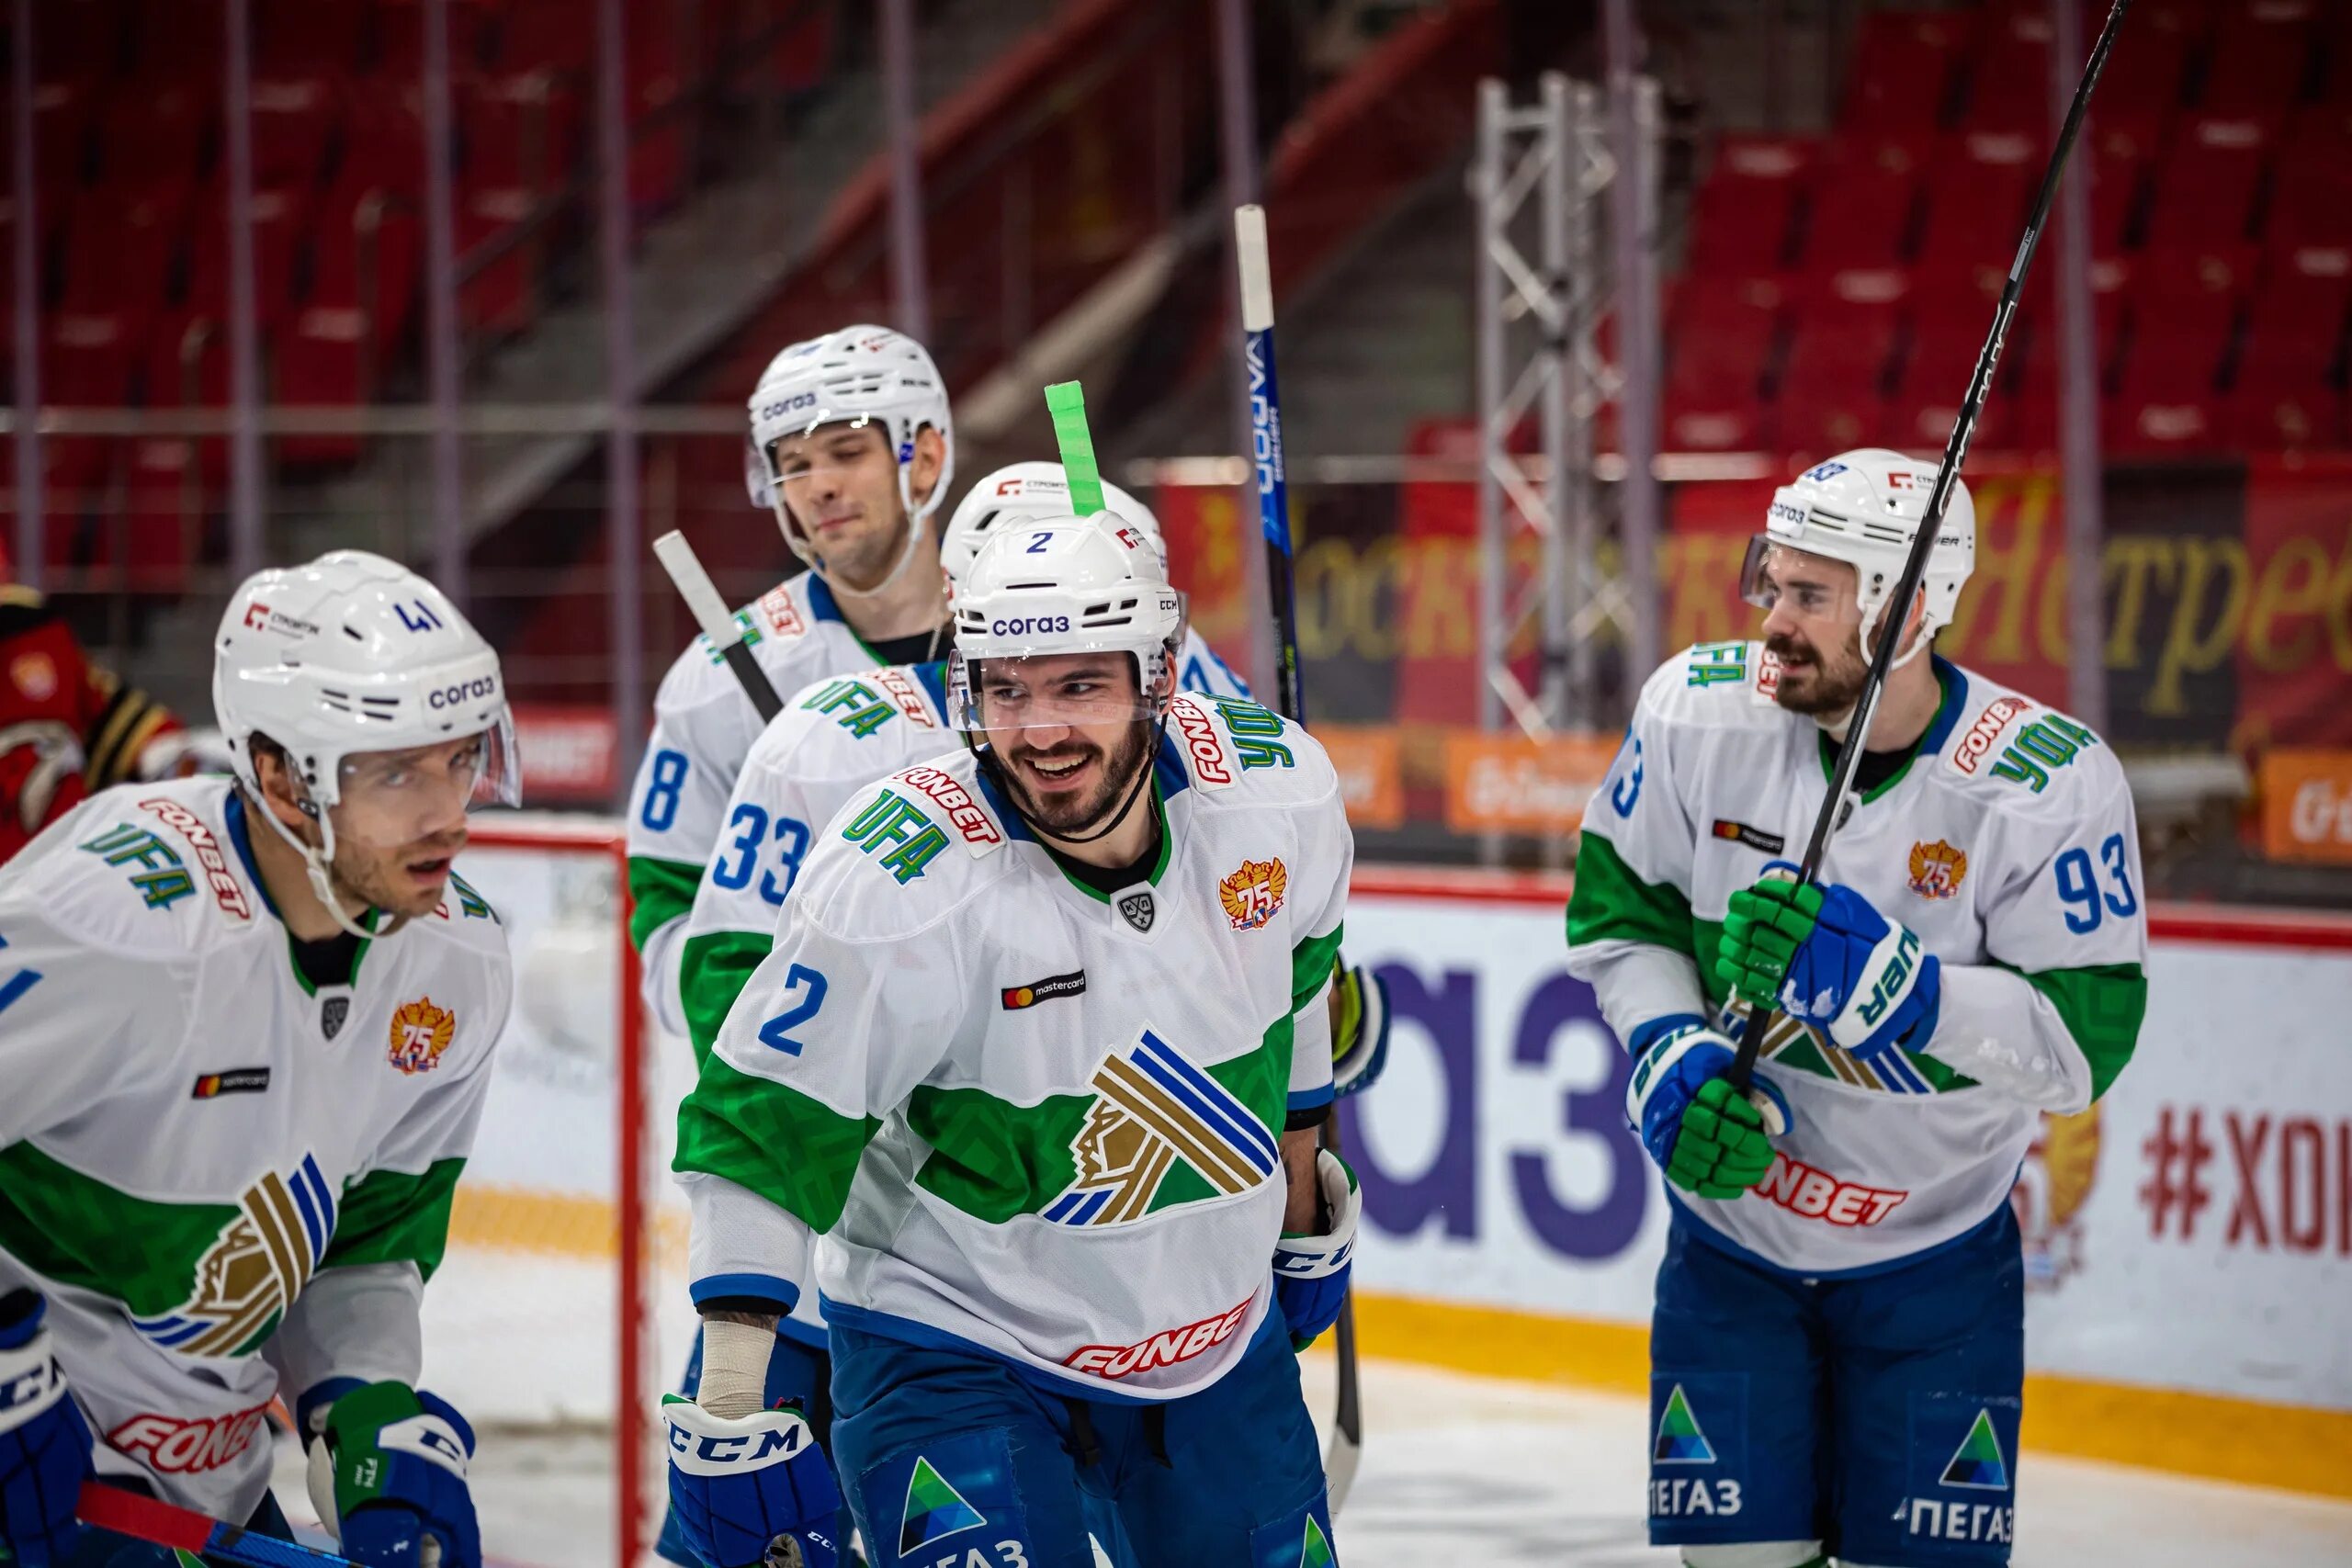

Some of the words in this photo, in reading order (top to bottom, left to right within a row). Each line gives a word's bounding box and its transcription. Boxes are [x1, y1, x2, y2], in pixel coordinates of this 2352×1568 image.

[1025, 532, 1055, 554] 2
[392, 599, 444, 633] 41
[992, 615, 1070, 637] согаз
[1160, 600, 1178, 611] CCM
[1687, 641, 1749, 687] FA
[429, 675, 495, 710] согаз
[799, 680, 898, 740] UFA
[1600, 721, 1645, 819] 3
[893, 766, 1001, 846] FONBET
[139, 797, 251, 920] FONBET
[712, 803, 812, 907] 33
[842, 787, 951, 887] UFA
[77, 822, 198, 912] UFA
[1922, 860, 1952, 892] 75
[2054, 831, 2137, 936] 93
[1237, 880, 1273, 920] 75
[757, 963, 828, 1057] 2
[1035, 976, 1085, 997] mastercard
[401, 1024, 435, 1059] 75
[1751, 1150, 1910, 1227] NBET
[1061, 1288, 1261, 1379] FONBE
[669, 1420, 799, 1462] CCM
[1909, 1497, 2013, 1544] ПЕГАЗ
